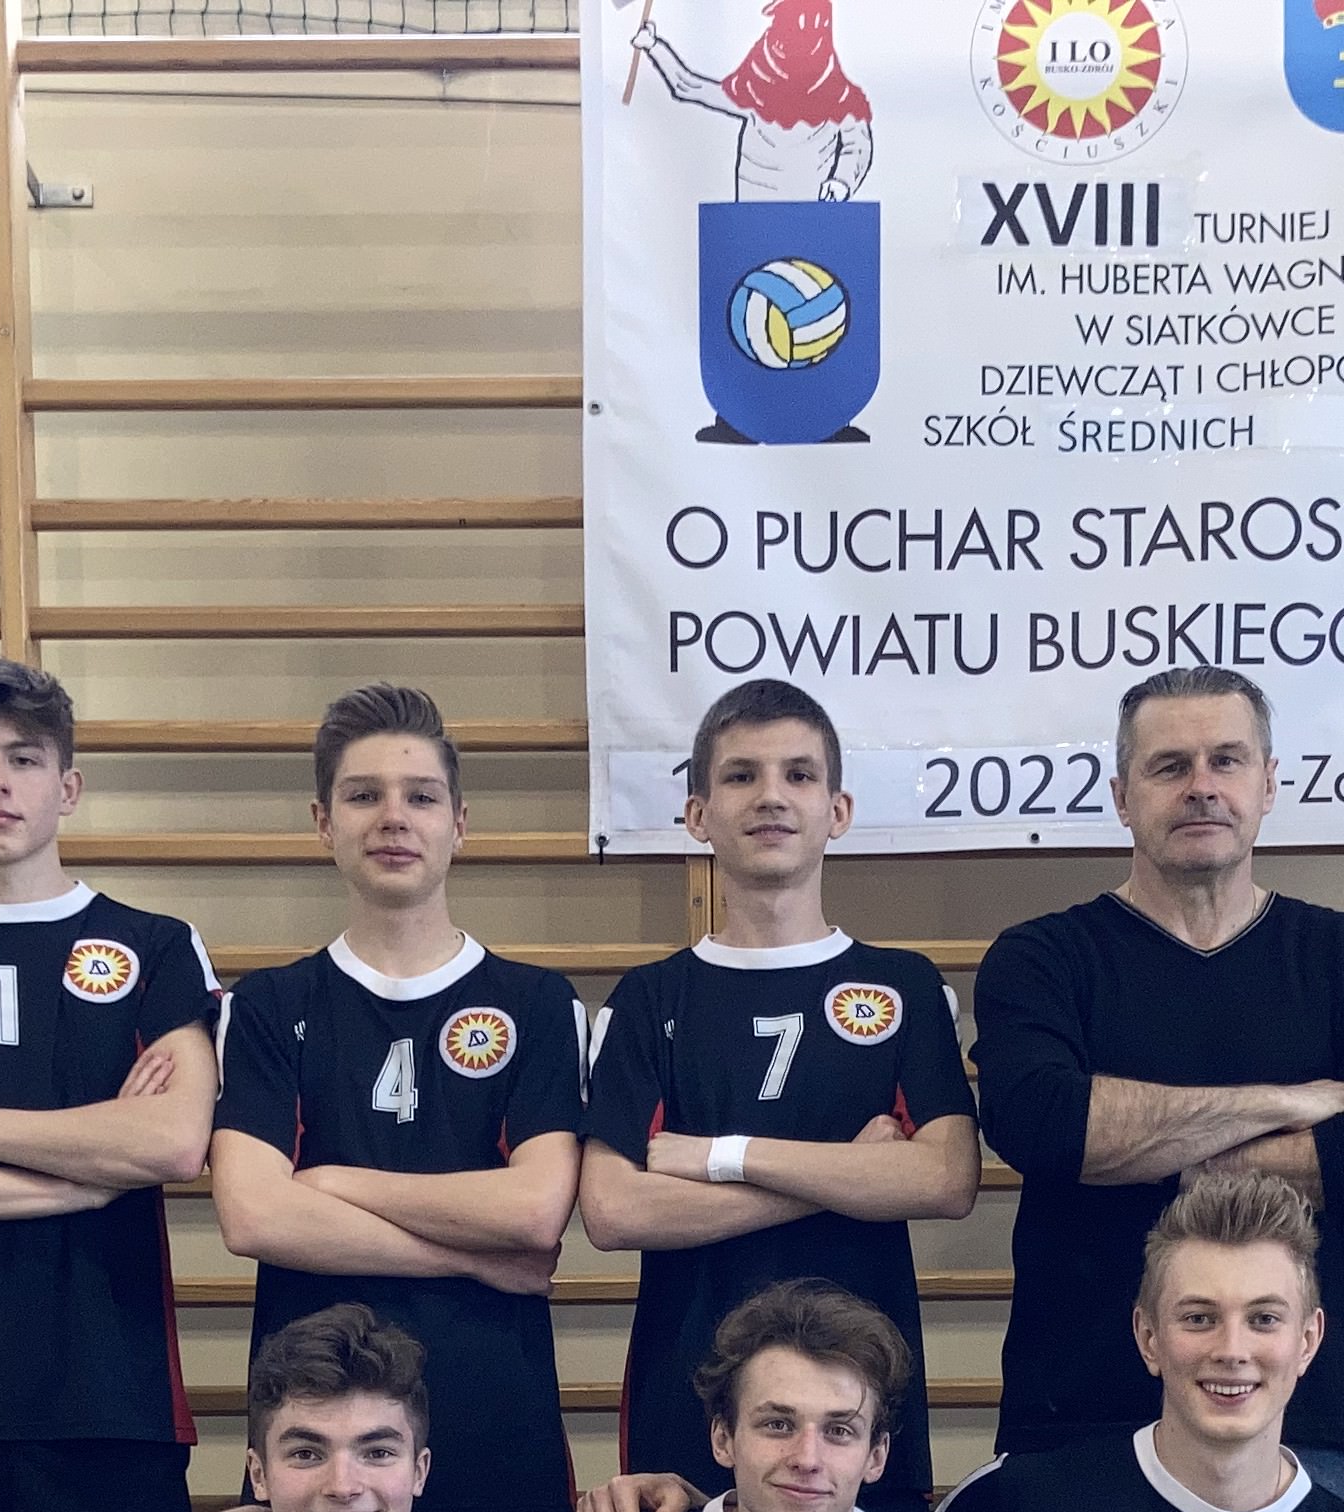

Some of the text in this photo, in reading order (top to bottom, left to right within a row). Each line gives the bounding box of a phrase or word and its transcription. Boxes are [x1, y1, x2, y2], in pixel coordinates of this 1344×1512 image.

[1049, 40, 1112, 63] I LO
[980, 181, 1161, 249] XVIII
[1194, 208, 1331, 245] TURNIEJ
[996, 263, 1046, 296] IM.
[1060, 262, 1211, 296] HUBERTA
[1075, 304, 1336, 346] W SIATKÓWCE
[980, 363, 1190, 402] DZIEWCZĄT
[1197, 367, 1204, 394] I
[923, 408, 1254, 454] SZKÓŁ ŚREDNICH
[665, 505, 728, 570] O
[757, 506, 1044, 573] PUCHAR
[670, 609, 999, 676] POWIATU
[925, 752, 1104, 818] 2022
[372, 1037, 418, 1124] 4
[752, 1012, 804, 1101] 7
